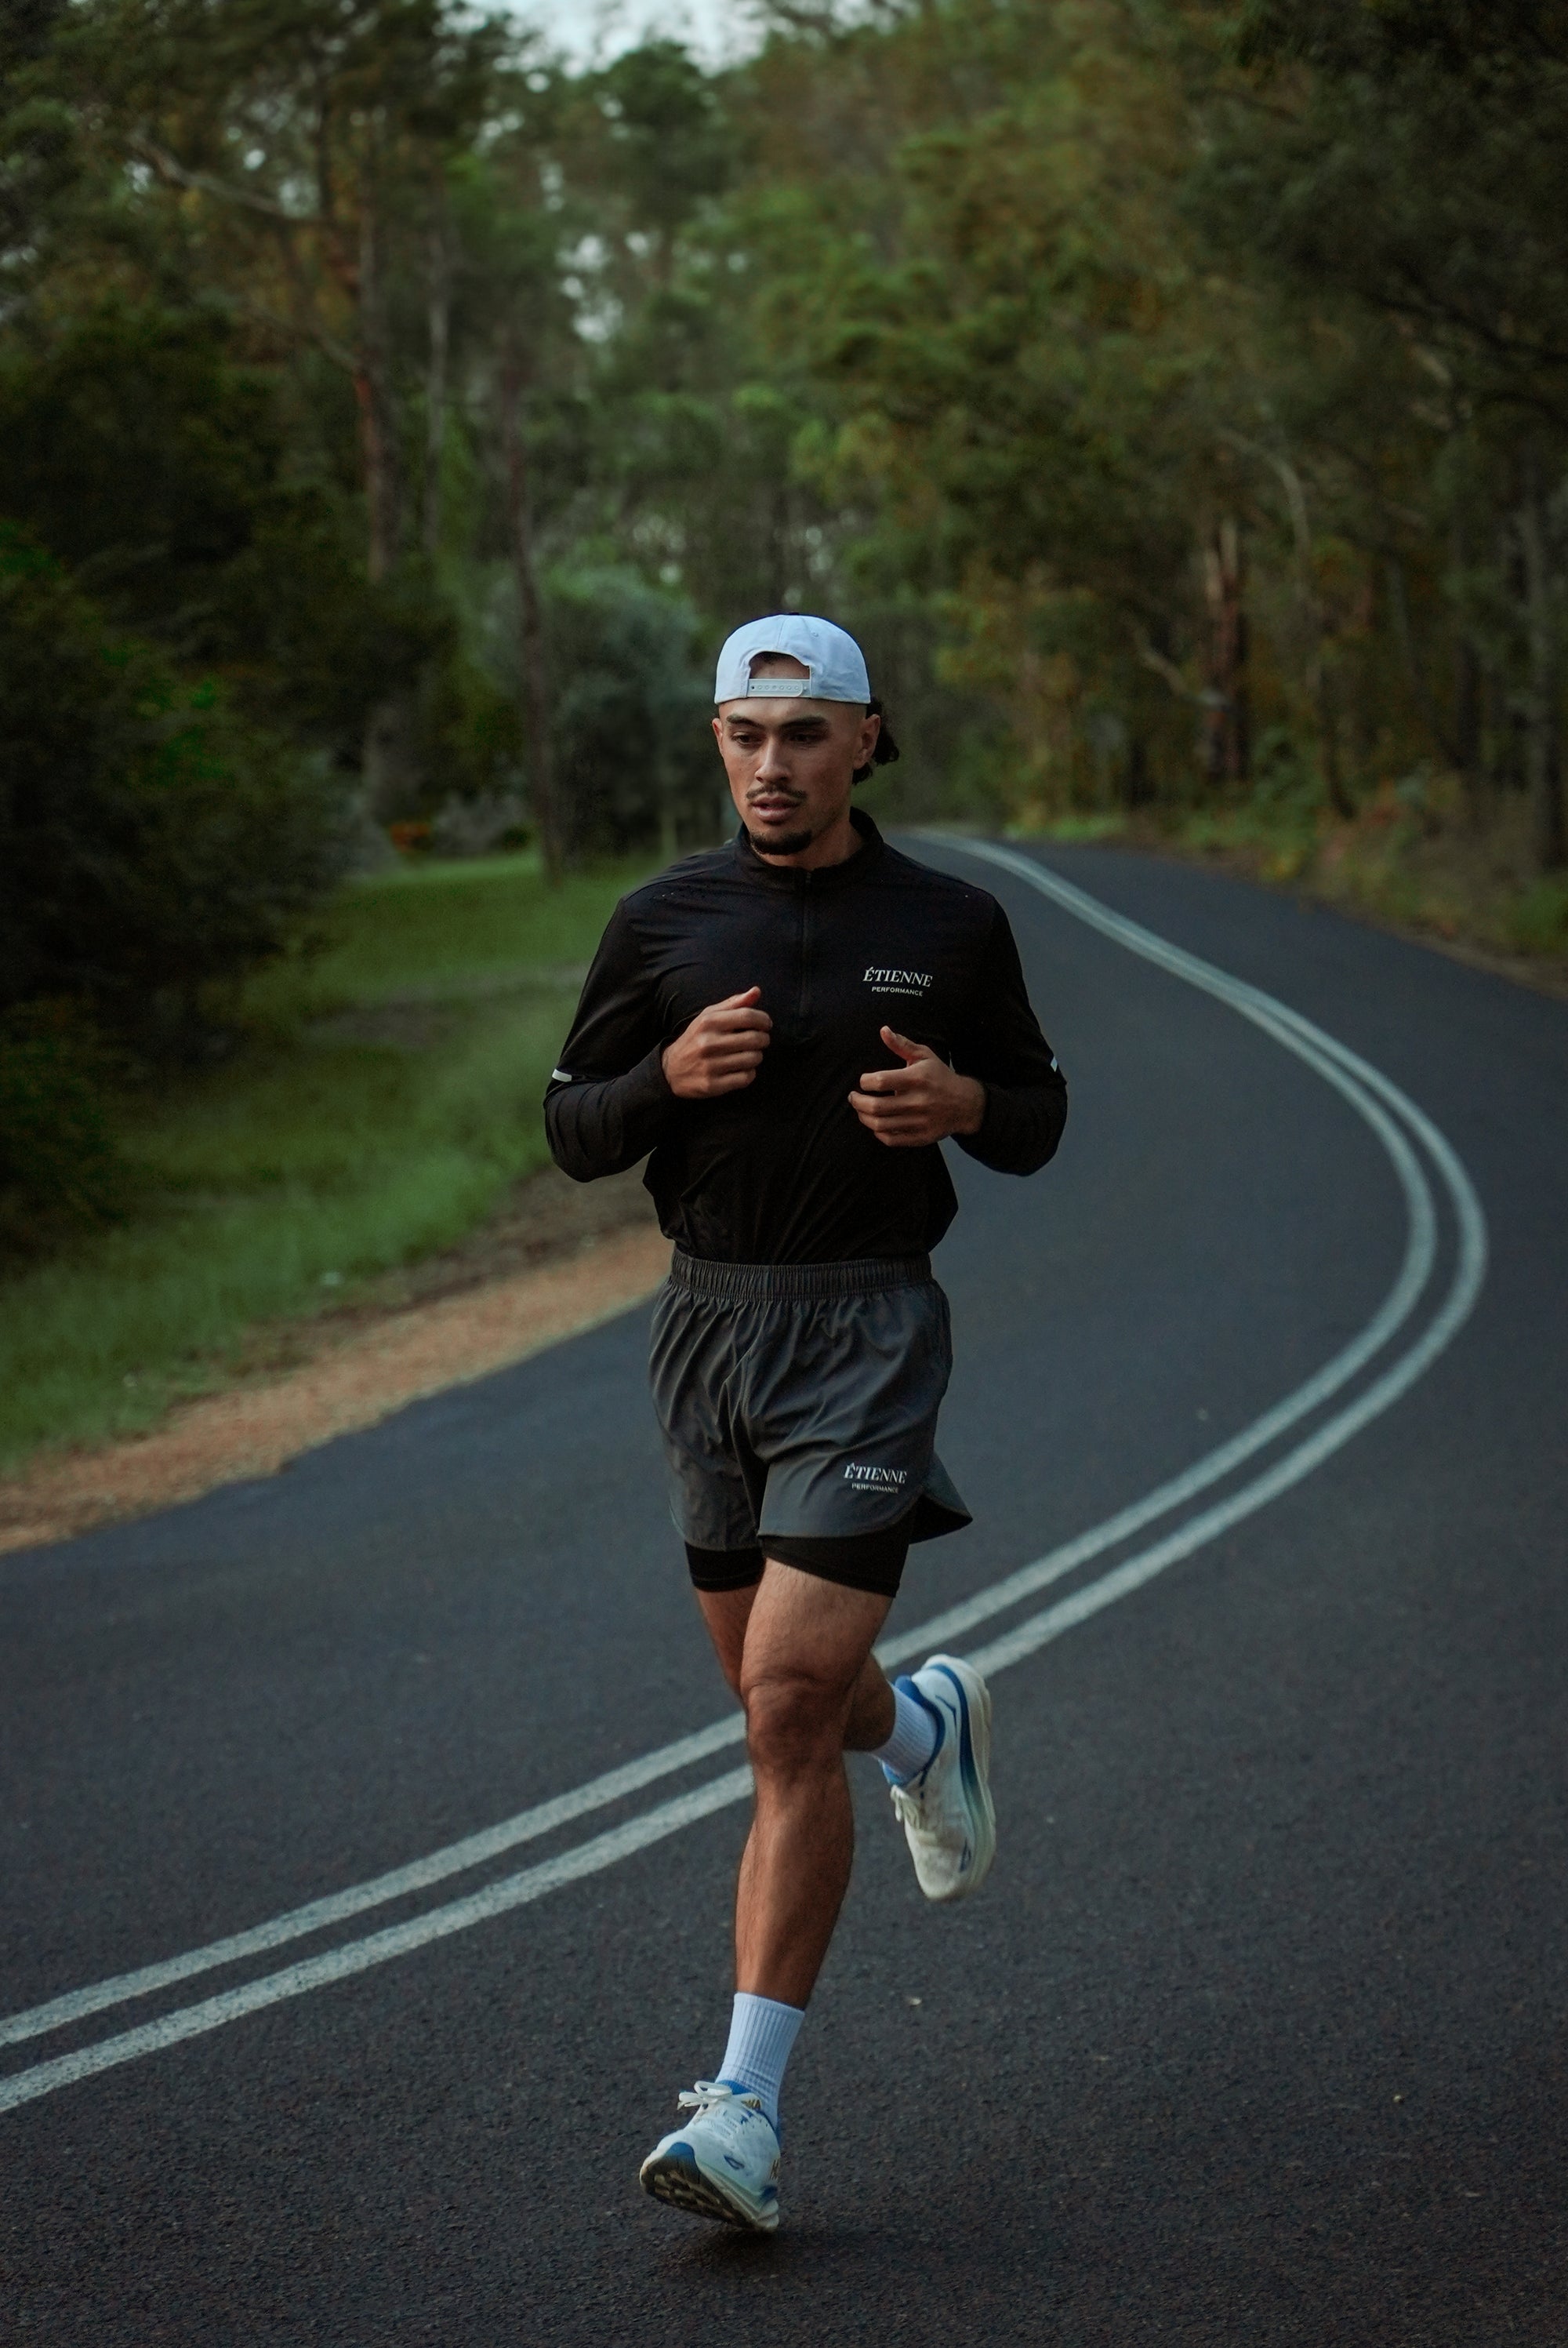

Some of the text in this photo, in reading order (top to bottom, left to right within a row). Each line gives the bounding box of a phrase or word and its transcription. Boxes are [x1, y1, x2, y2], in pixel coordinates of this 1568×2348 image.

[862, 966, 933, 987] ÉTIENNE
[871, 986, 924, 997] PERFORMANCE
[844, 1462, 907, 1484] ÉTIENNE
